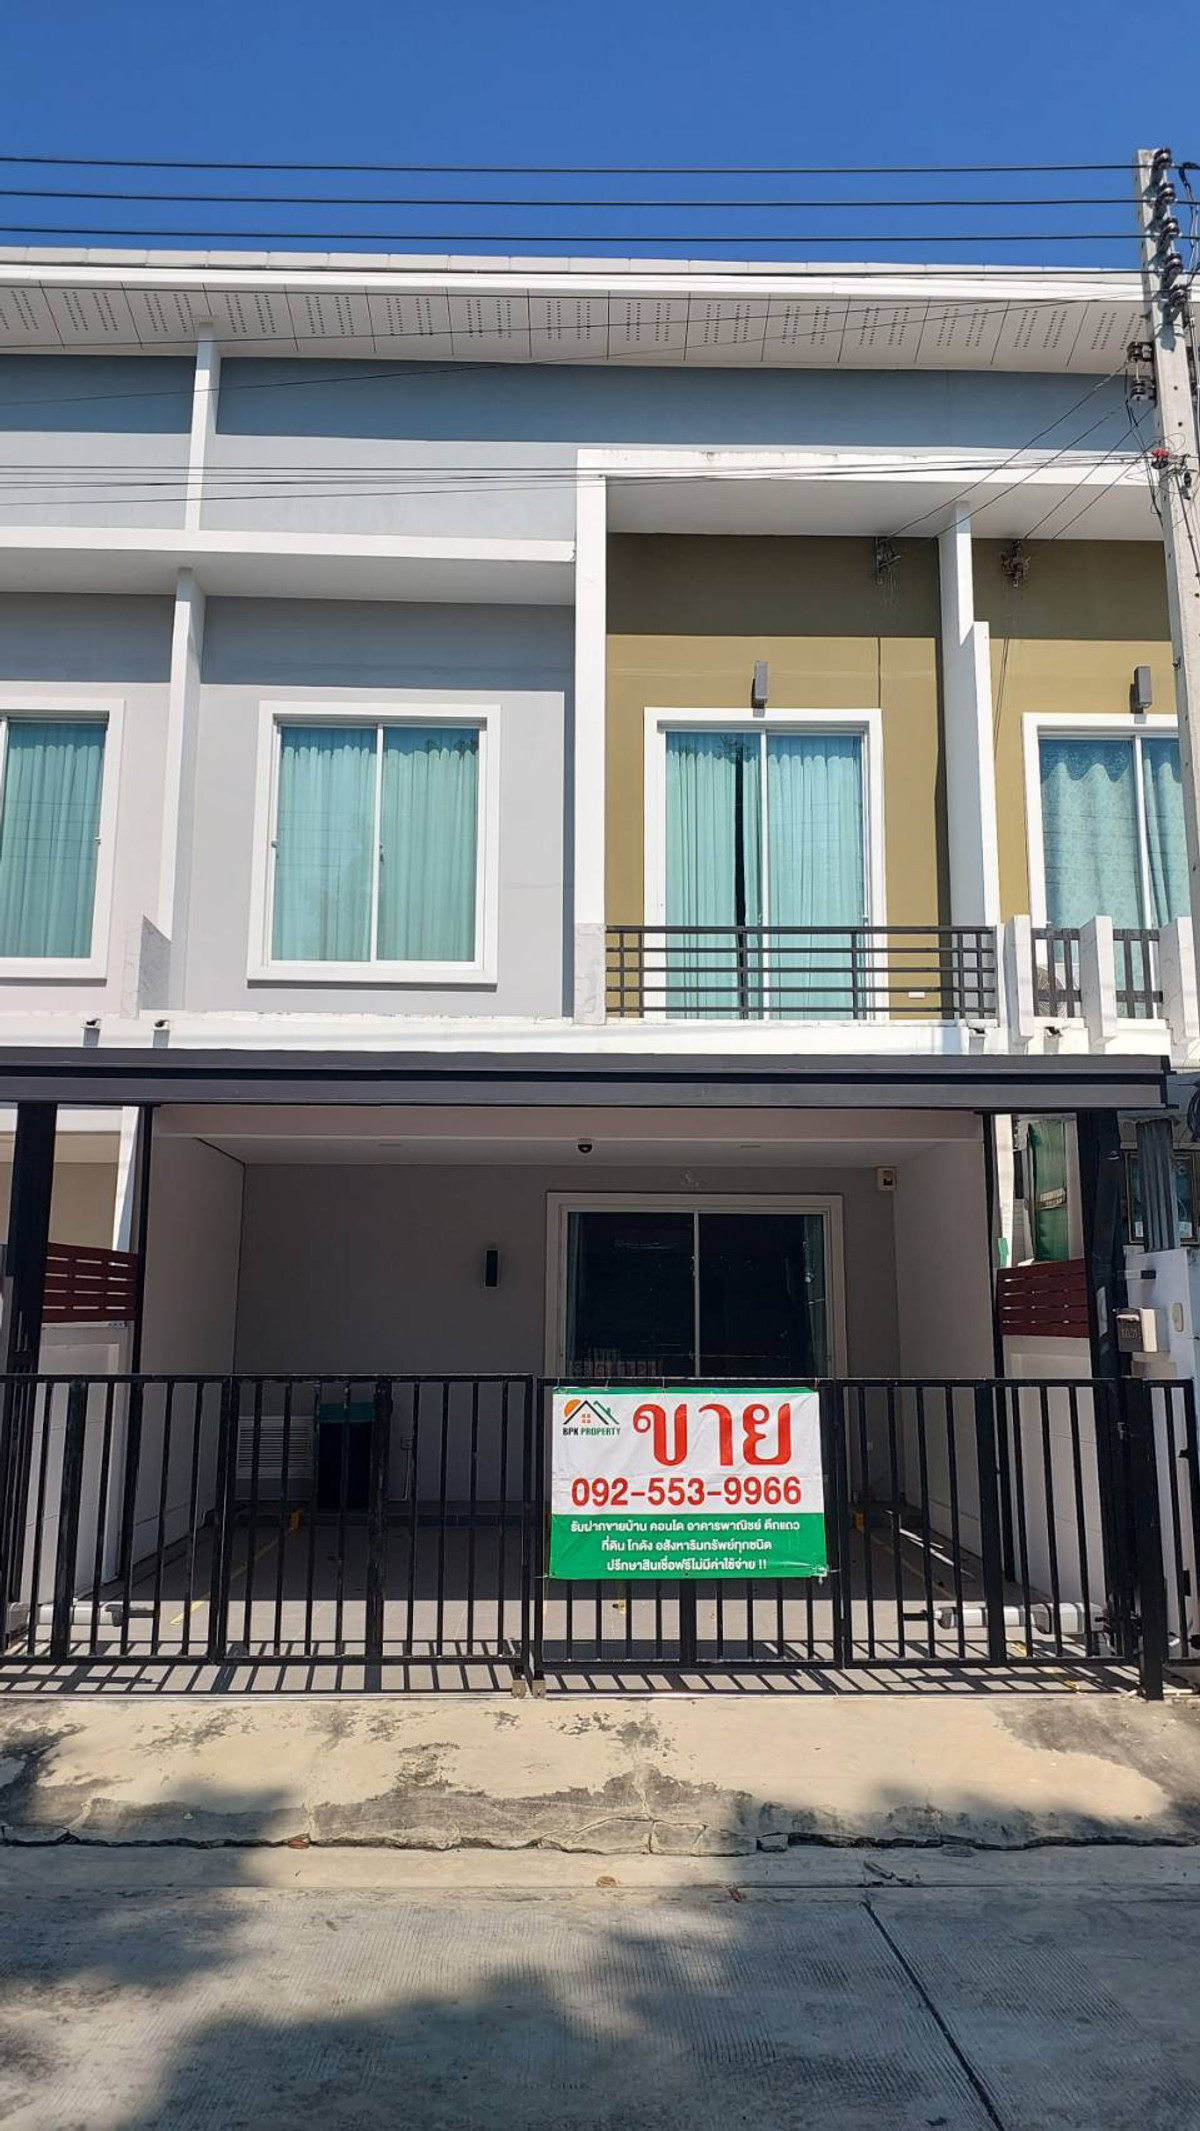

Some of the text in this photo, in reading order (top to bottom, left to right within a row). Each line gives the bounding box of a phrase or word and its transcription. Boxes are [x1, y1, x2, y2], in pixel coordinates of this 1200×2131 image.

[563, 1427, 621, 1436] BPK PROPERTY
[633, 1402, 792, 1466] ขาย
[571, 1476, 802, 1507] 092-553-9966
[758, 1558, 767, 1570] !!
